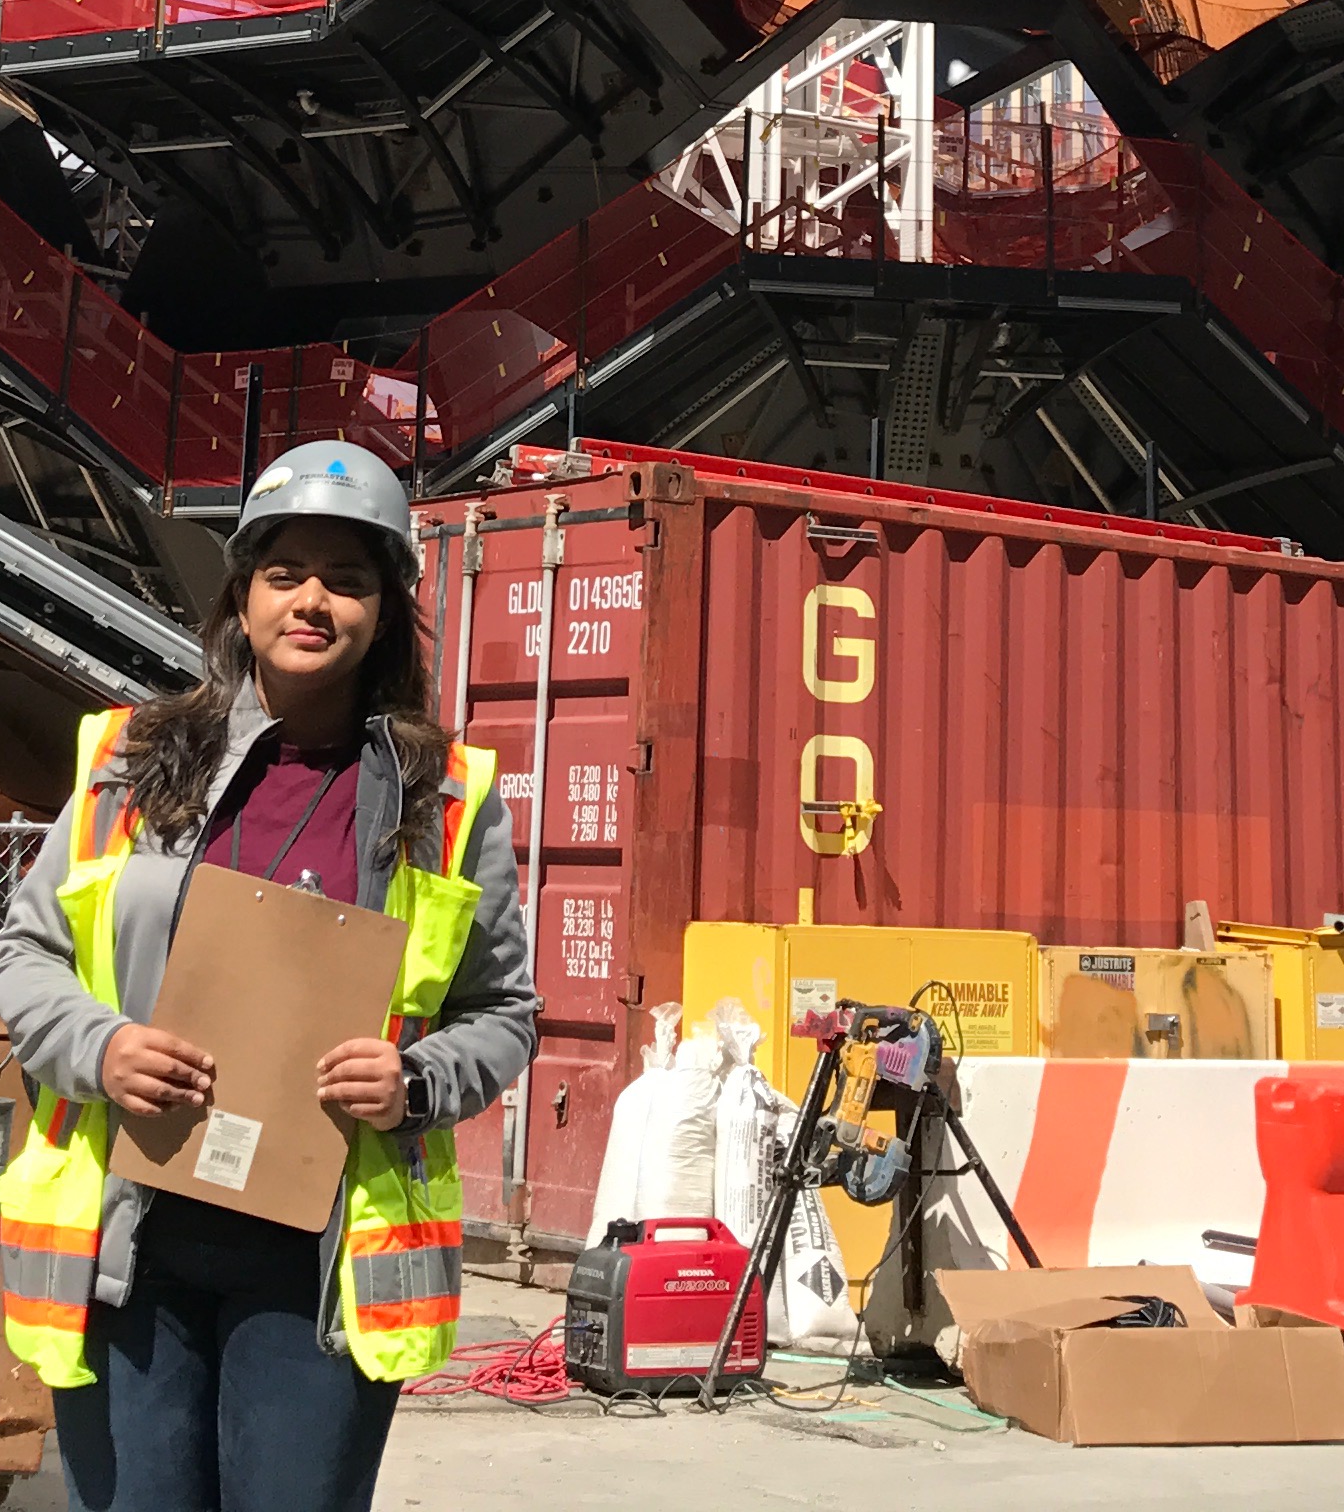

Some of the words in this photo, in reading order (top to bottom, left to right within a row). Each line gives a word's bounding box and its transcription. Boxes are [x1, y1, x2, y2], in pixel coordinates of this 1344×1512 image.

[567, 620, 611, 655] 2210
[499, 773, 535, 799] GROSS
[569, 765, 601, 784] 67.200
[607, 764, 619, 783] Lb
[567, 783, 600, 802] 30.480
[606, 804, 617, 822] Lb
[600, 919, 614, 940] Kg
[561, 939, 587, 959] 1.172
[1091, 958, 1133, 971] JUSTRITE
[930, 983, 1009, 1002] FLAMMABLE
[930, 1004, 954, 1018] KEEP
[956, 1005, 979, 1018] FIRE
[980, 1005, 1009, 1018] AWAY
[809, 1210, 824, 1247] Winter
[576, 1266, 605, 1280] HONDA
[677, 1269, 715, 1278] HONDA
[819, 1260, 835, 1304] SAKRETE
